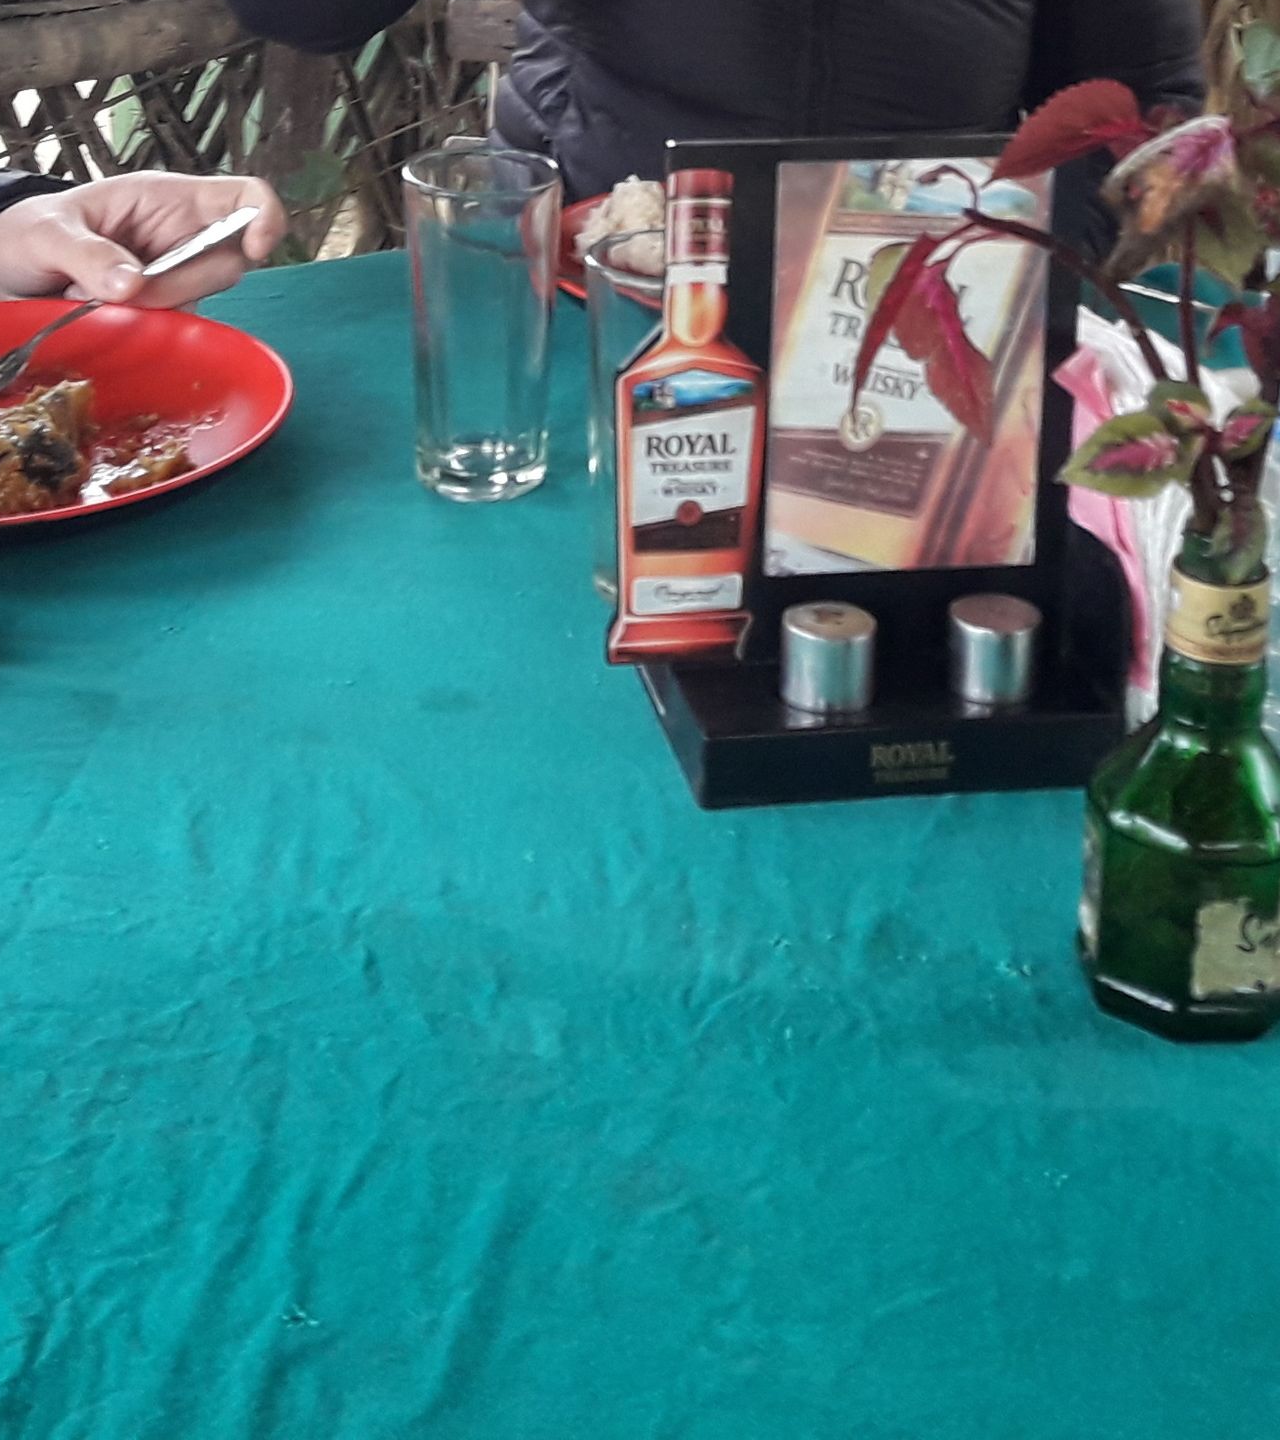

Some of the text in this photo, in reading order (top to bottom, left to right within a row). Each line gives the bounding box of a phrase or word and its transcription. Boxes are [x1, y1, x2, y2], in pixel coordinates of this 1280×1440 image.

[832, 362, 921, 401] WISKY
[646, 433, 736, 459] ROYAL
[650, 460, 733, 474] TREASURE
[870, 742, 955, 768] ROYAL
